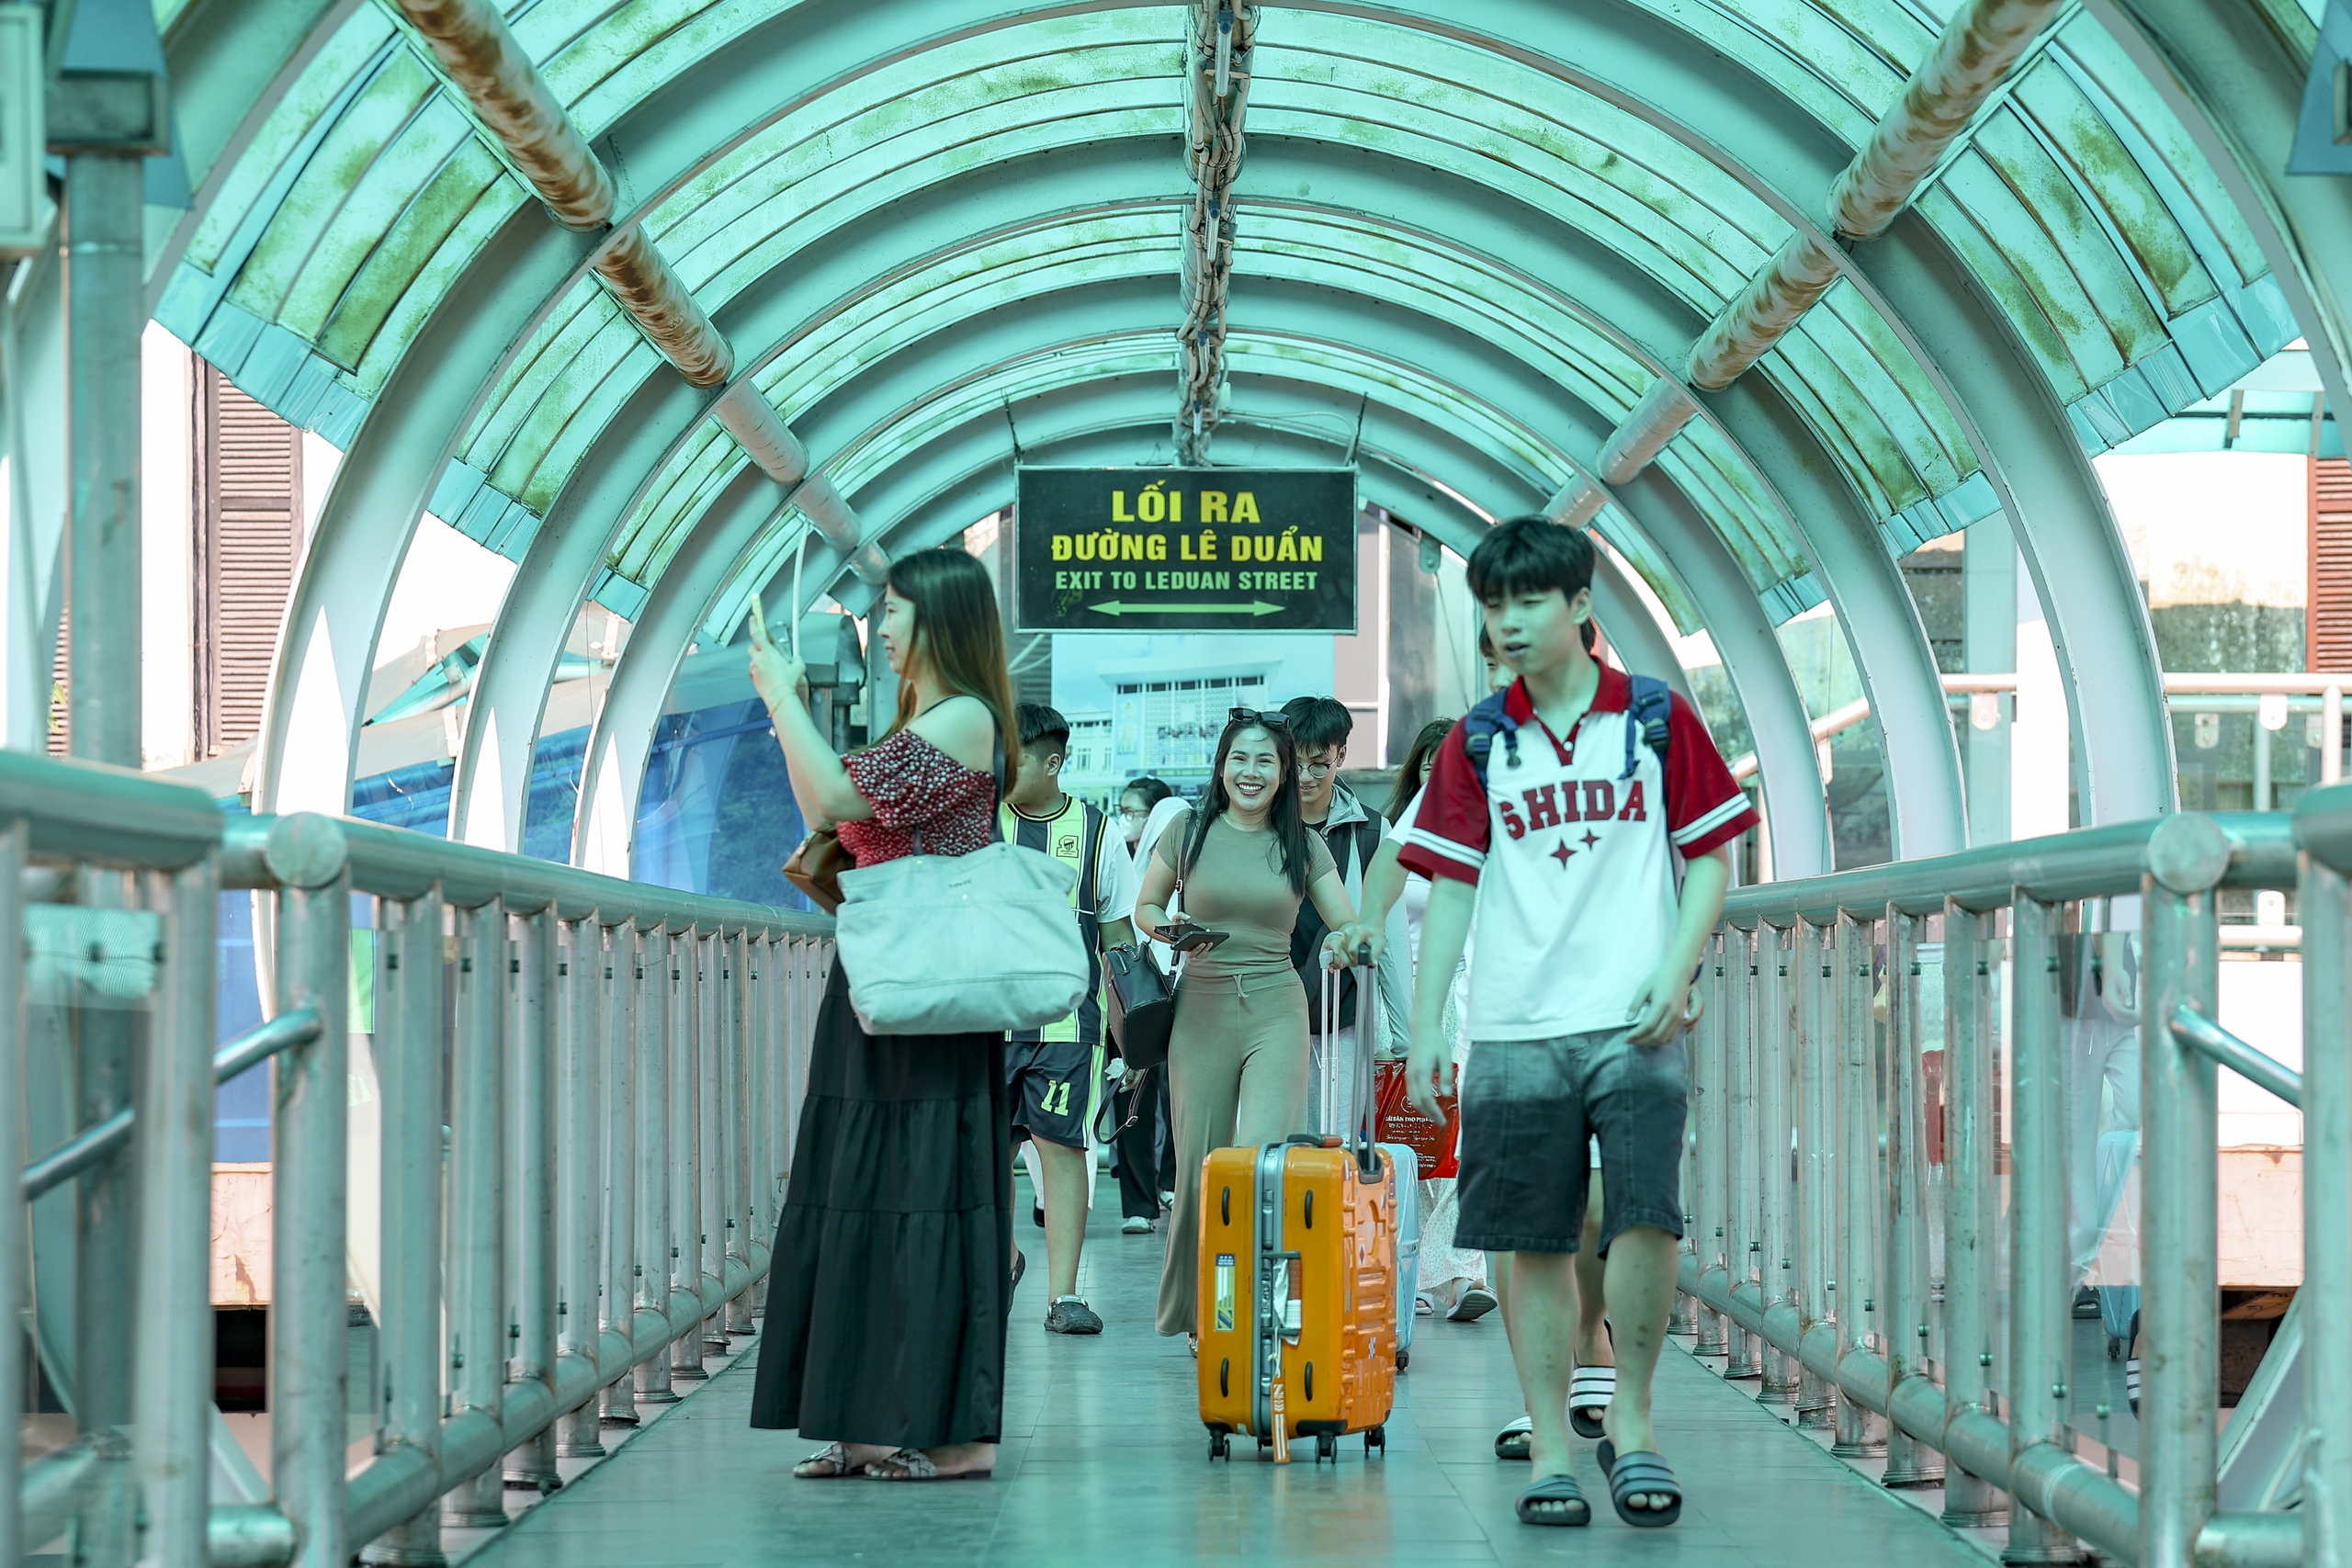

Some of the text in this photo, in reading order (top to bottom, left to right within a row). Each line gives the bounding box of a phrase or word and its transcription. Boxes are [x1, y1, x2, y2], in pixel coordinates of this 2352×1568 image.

[1112, 479, 1261, 524] LỐI RA
[1051, 525, 1323, 562] ĐƯỜNG LÊ DUẨN
[1056, 570, 1318, 591] EXIT TO LEDUAN STREET
[1040, 1079, 1071, 1117] 11
